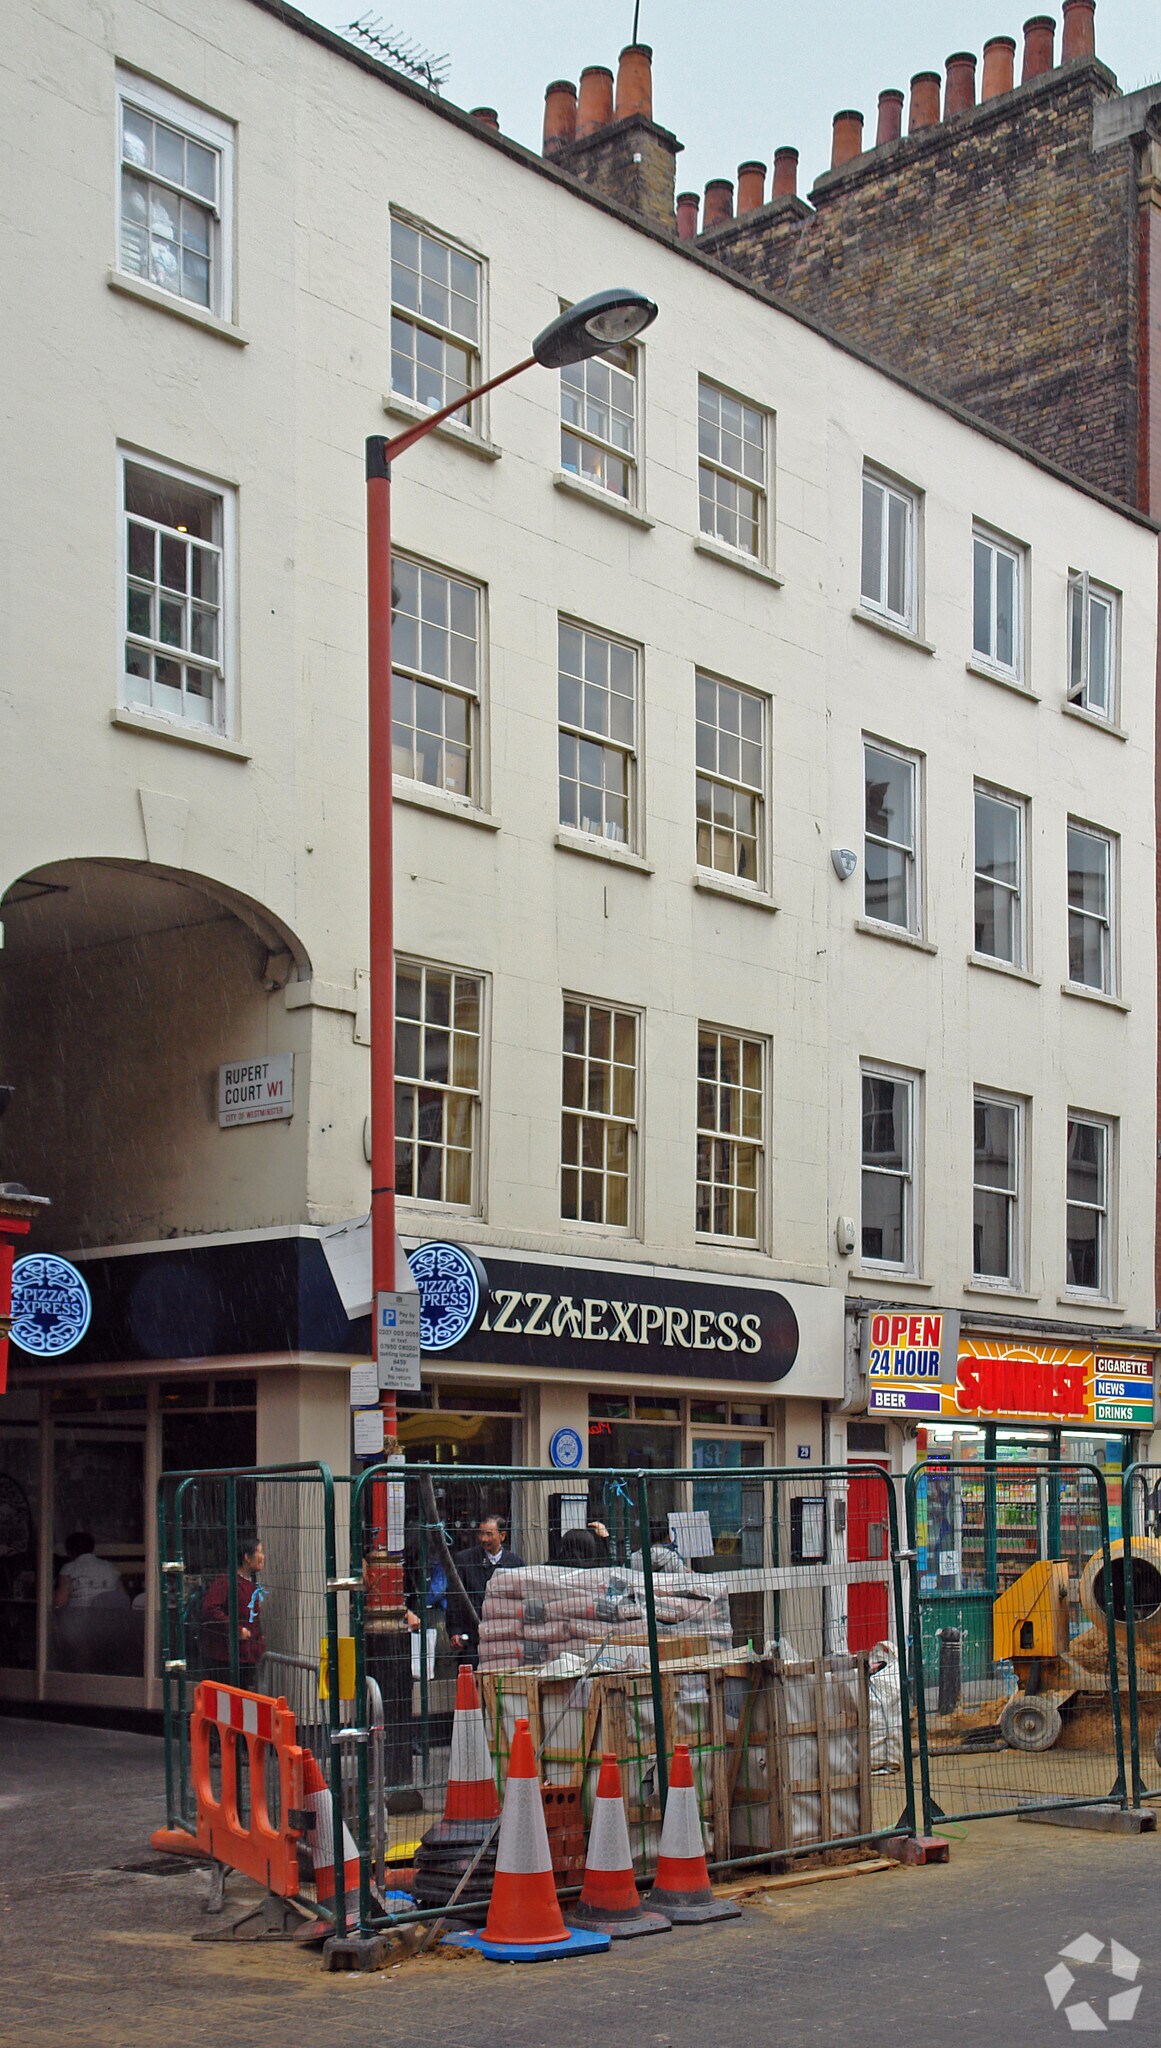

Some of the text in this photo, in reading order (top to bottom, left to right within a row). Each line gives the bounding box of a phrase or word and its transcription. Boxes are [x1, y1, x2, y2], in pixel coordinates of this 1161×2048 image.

[225, 1063, 269, 1086] RUPERT
[225, 1080, 283, 1105] COURT W1
[225, 1106, 284, 1122] CITY OF WESTMINSTER
[416, 1279, 457, 1293] PIZZA
[23, 1288, 69, 1303] PIZZA
[421, 1292, 468, 1307] PRESS
[10, 1300, 81, 1316] EXPRESS
[399, 1310, 408, 1319] Pay
[385, 1311, 395, 1325] P
[480, 1289, 763, 1354] ZZAEXPRESS
[871, 1314, 943, 1347] OPEN
[869, 1350, 940, 1378] 24 HOUR
[1097, 1358, 1148, 1375] CIGARETTE
[956, 1355, 1088, 1416] SUNRISE
[1097, 1382, 1125, 1396] NEWS
[875, 1391, 907, 1408] BEER
[1097, 1405, 1134, 1420] DRINKS
[800, 1447, 810, 1458] 29
